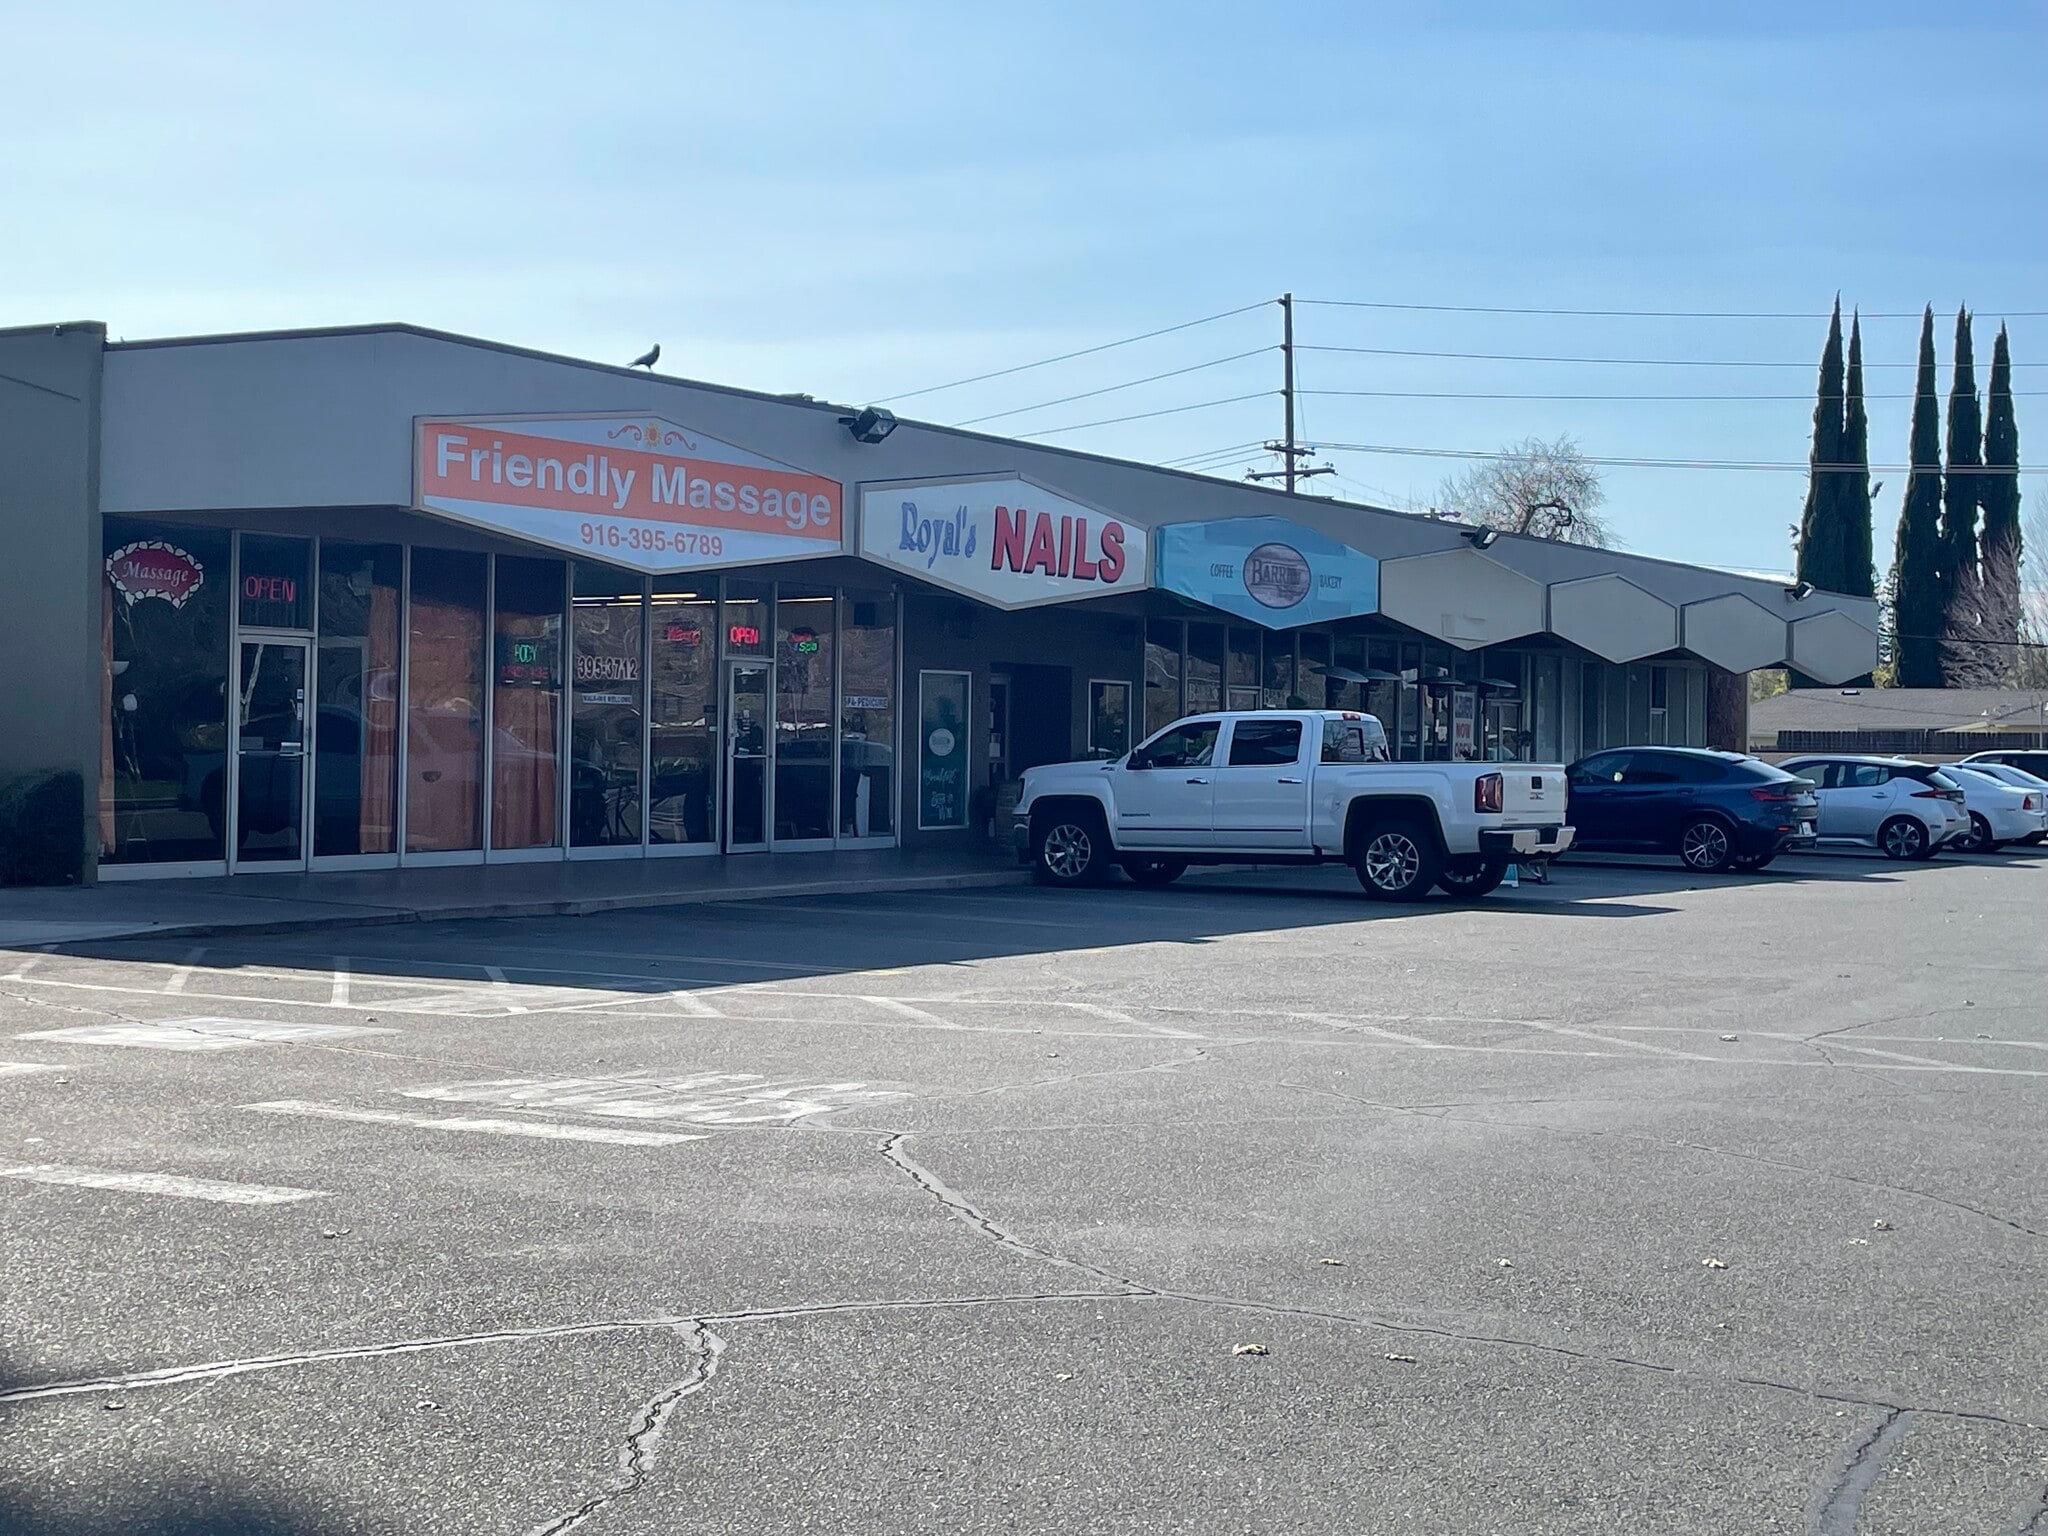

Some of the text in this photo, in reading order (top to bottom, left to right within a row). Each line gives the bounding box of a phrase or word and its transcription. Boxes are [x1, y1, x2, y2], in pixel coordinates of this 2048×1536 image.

[436, 434, 831, 530] Friendly Massage
[580, 523, 723, 557] 916-395-6789
[898, 502, 1126, 584] Royal's NAILS
[122, 560, 189, 588] Massage
[1210, 563, 1234, 579] COFFEE
[1319, 574, 1343, 589] BAKERY
[244, 576, 296, 602] OPEN
[729, 626, 760, 645] OPEN
[798, 642, 818, 654] Spa
[577, 655, 638, 680] 395-3712
